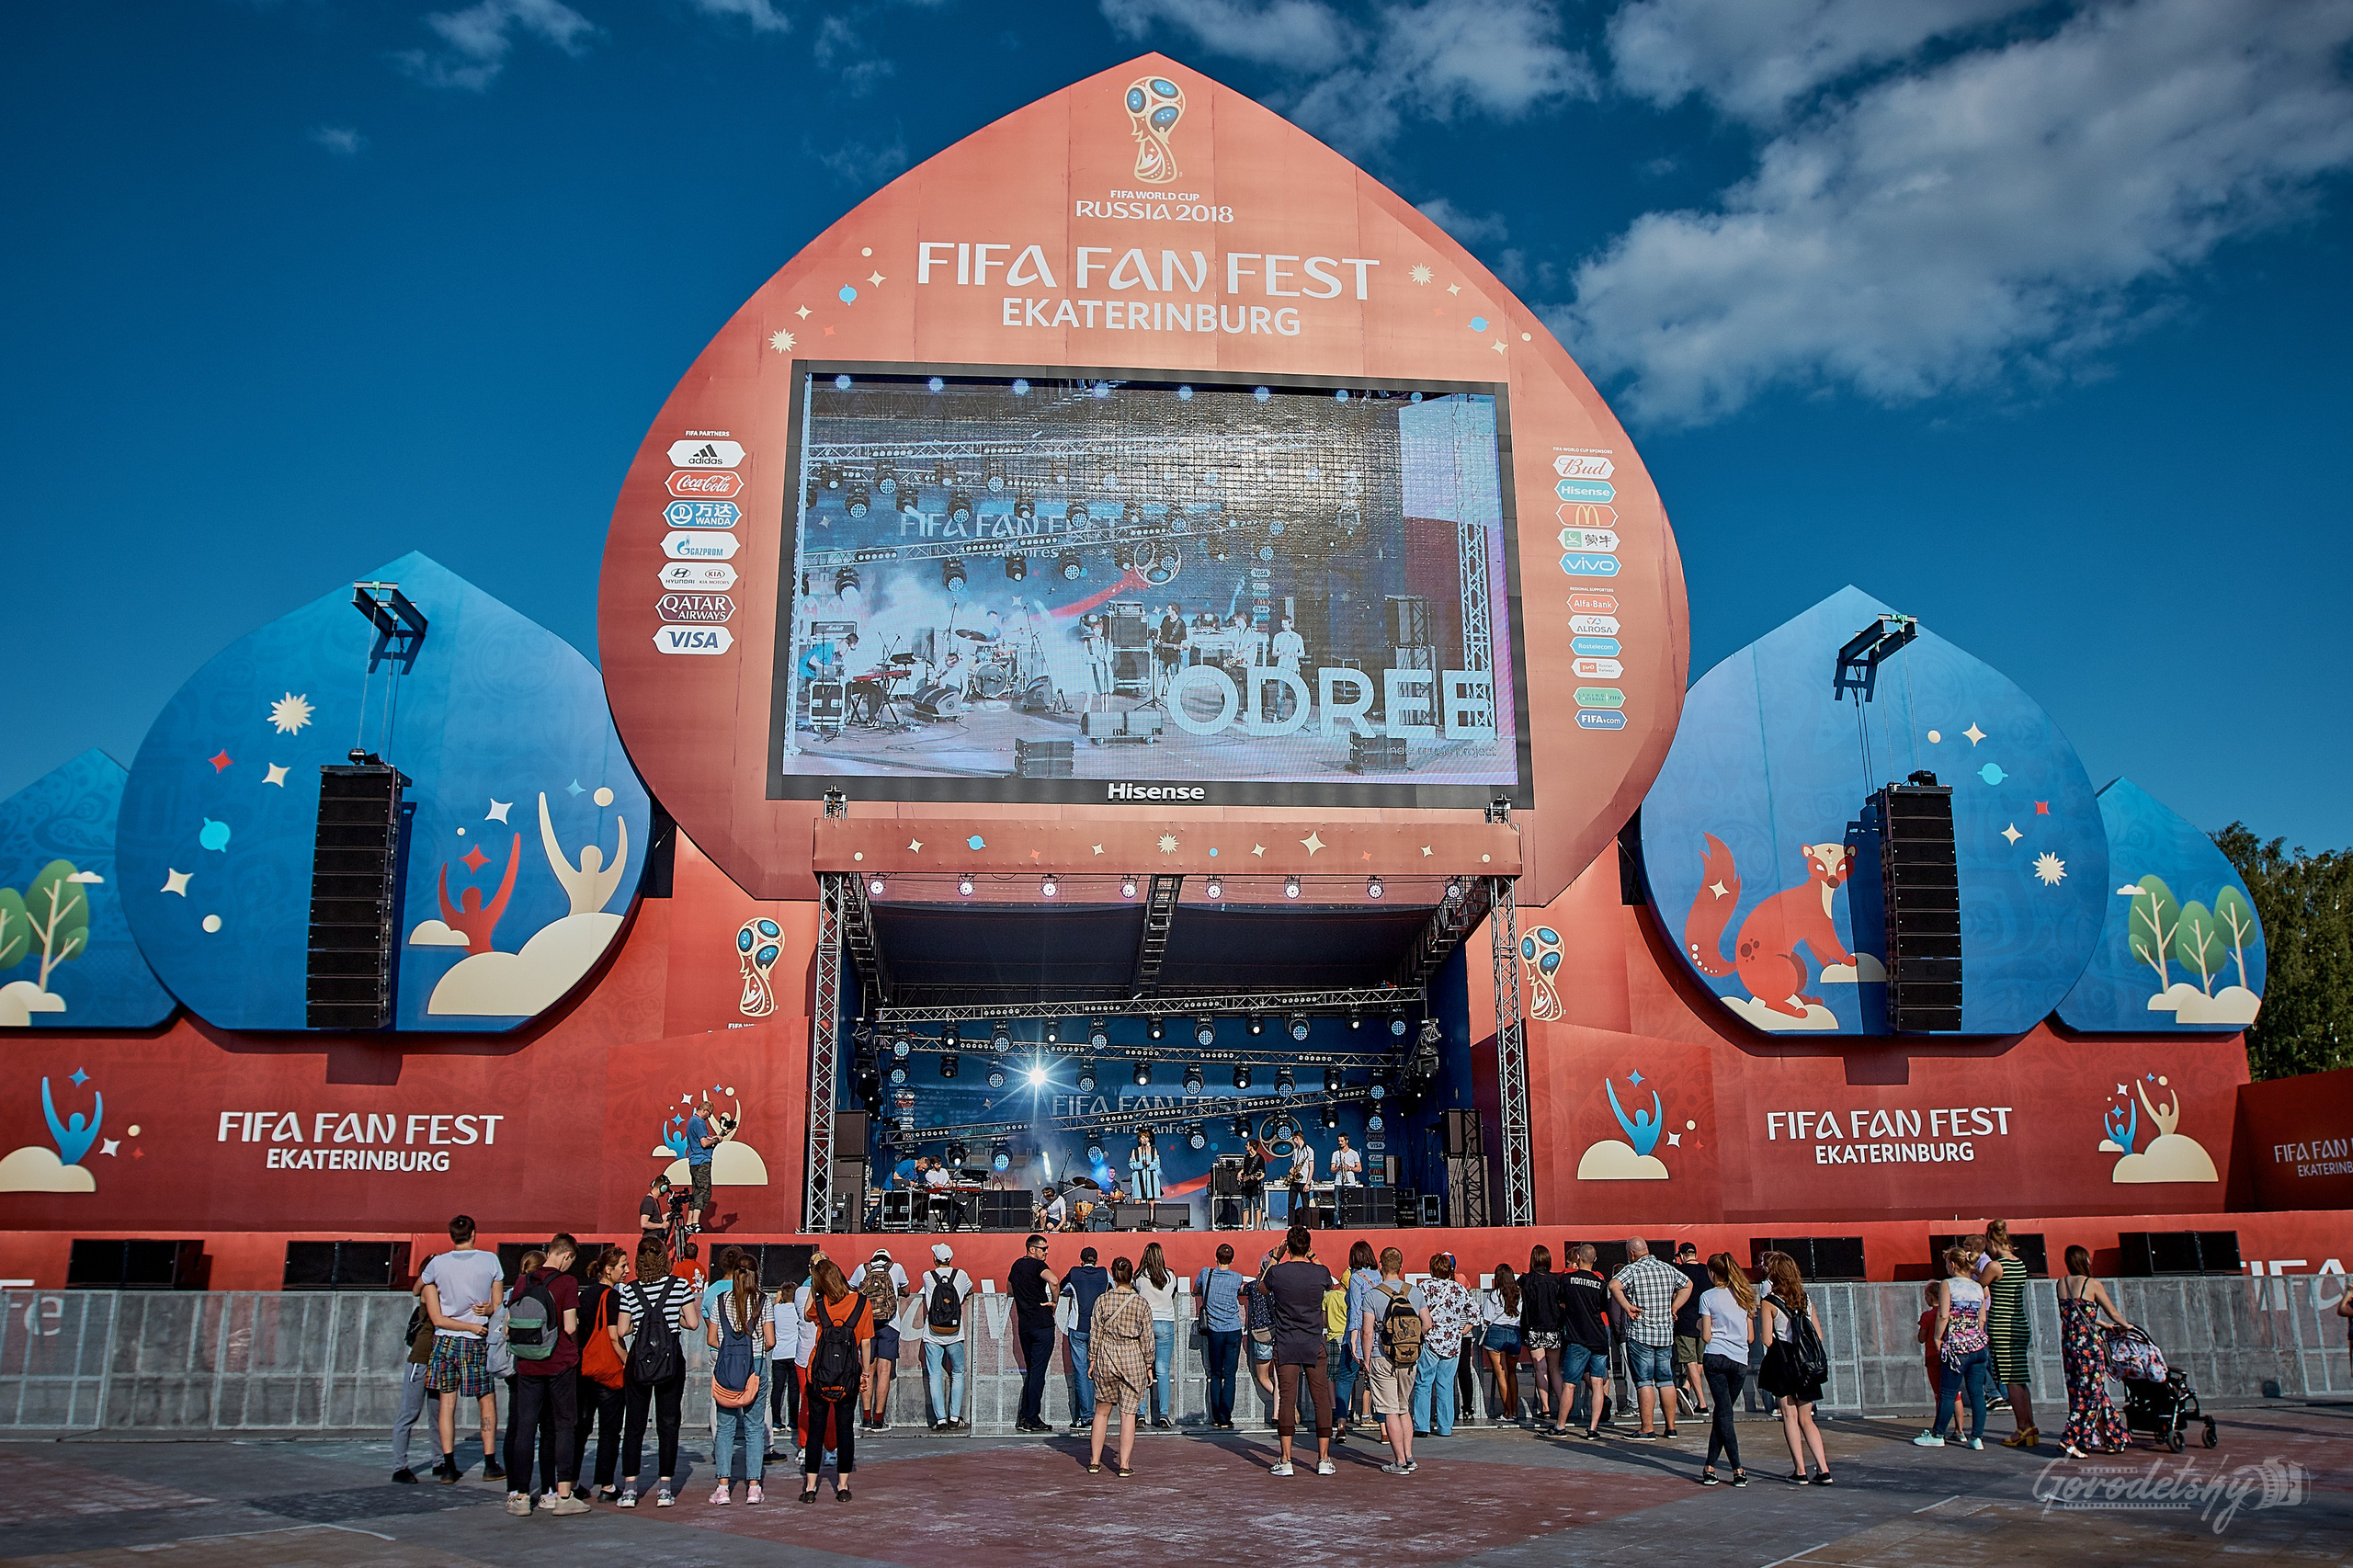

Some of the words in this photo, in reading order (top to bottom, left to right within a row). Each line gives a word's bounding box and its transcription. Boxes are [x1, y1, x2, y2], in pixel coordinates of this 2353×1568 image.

[1110, 189, 1132, 199] FIFA
[1135, 190, 1176, 199] WORLD
[1177, 192, 1199, 201] CUP
[1075, 200, 1172, 222] RUSSIA
[1176, 203, 1235, 223] 2018
[918, 242, 1058, 289] FIFA
[1076, 246, 1207, 292] FAN
[1226, 252, 1381, 301] FEST
[1002, 298, 1301, 336] EKATERINBURG
[688, 457, 722, 465] adidas
[1558, 458, 1607, 475] Bud
[1561, 486, 1610, 496] Hisense
[900, 513, 968, 537] FIFA
[976, 514, 1040, 537] FAN
[690, 548, 723, 556] GAZPROM
[663, 596, 726, 613] QATAR
[677, 611, 726, 620] AIRWAYS
[665, 631, 719, 648] VISA
[1166, 665, 1495, 741] ODREE
[1108, 782, 1205, 800] Hisense
[1052, 1095, 1109, 1116] FIFA
[217, 1111, 303, 1142] FIFA
[313, 1112, 397, 1144] FAN
[405, 1114, 504, 1145] FEST
[1767, 1111, 1844, 1141] FIFA
[1850, 1109, 1923, 1139] FAN
[1929, 1107, 2013, 1137] FEST
[266, 1148, 450, 1172] EKATERINBURG
[1815, 1142, 1974, 1165] EKATERINBURG
[2274, 1142, 2310, 1164] FIFA
[2312, 1139, 2347, 1160] FAN
[2240, 1258, 2347, 1312] IFA
